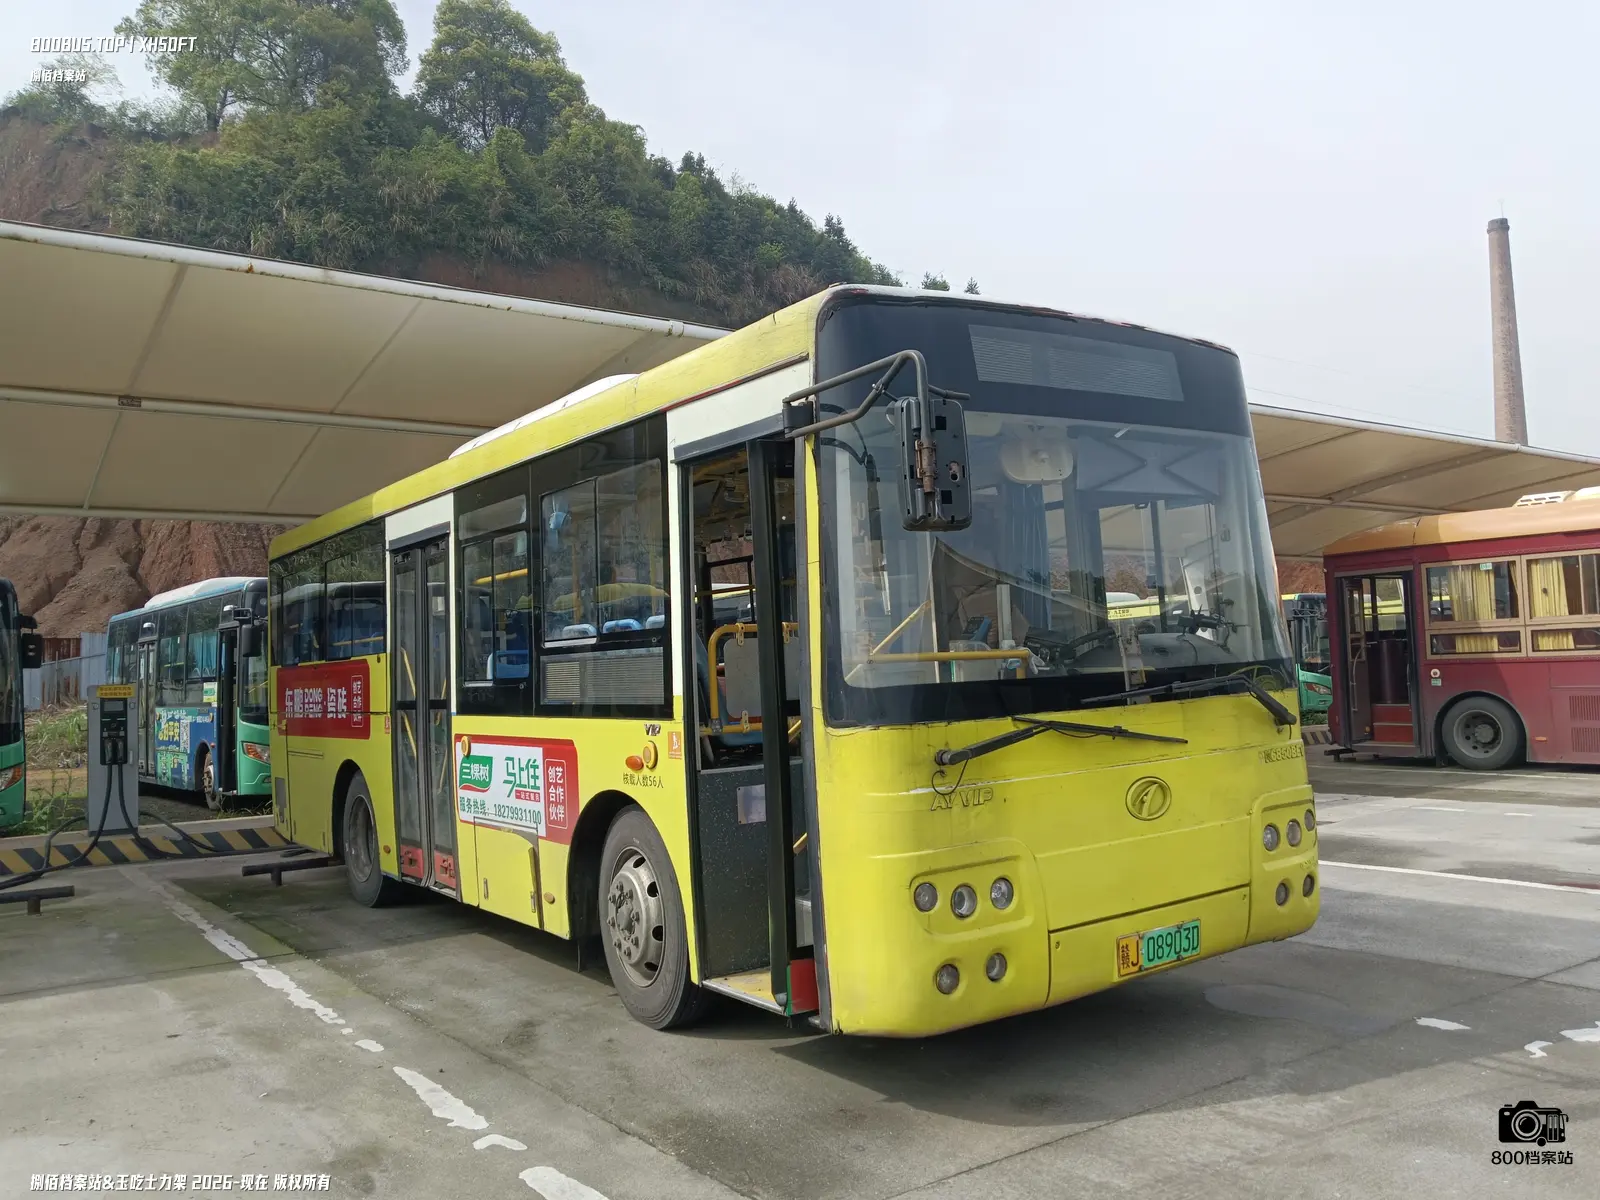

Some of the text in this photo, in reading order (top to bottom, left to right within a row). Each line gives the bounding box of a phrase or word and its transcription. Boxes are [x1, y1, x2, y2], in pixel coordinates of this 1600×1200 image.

[304, 687, 323, 703] DONG
[644, 723, 661, 736] VIP
[461, 763, 490, 782] 三棵树
[503, 756, 541, 798] 马上住
[548, 766, 564, 783] 创艺
[622, 772, 664, 789] 核载人数56人
[548, 785, 564, 803] 合作
[959, 787, 994, 807] VIP
[494, 803, 542, 825] 18279931100
[549, 803, 565, 822] 伙伴
[1121, 925, 1200, 970] 赣J 08903D
